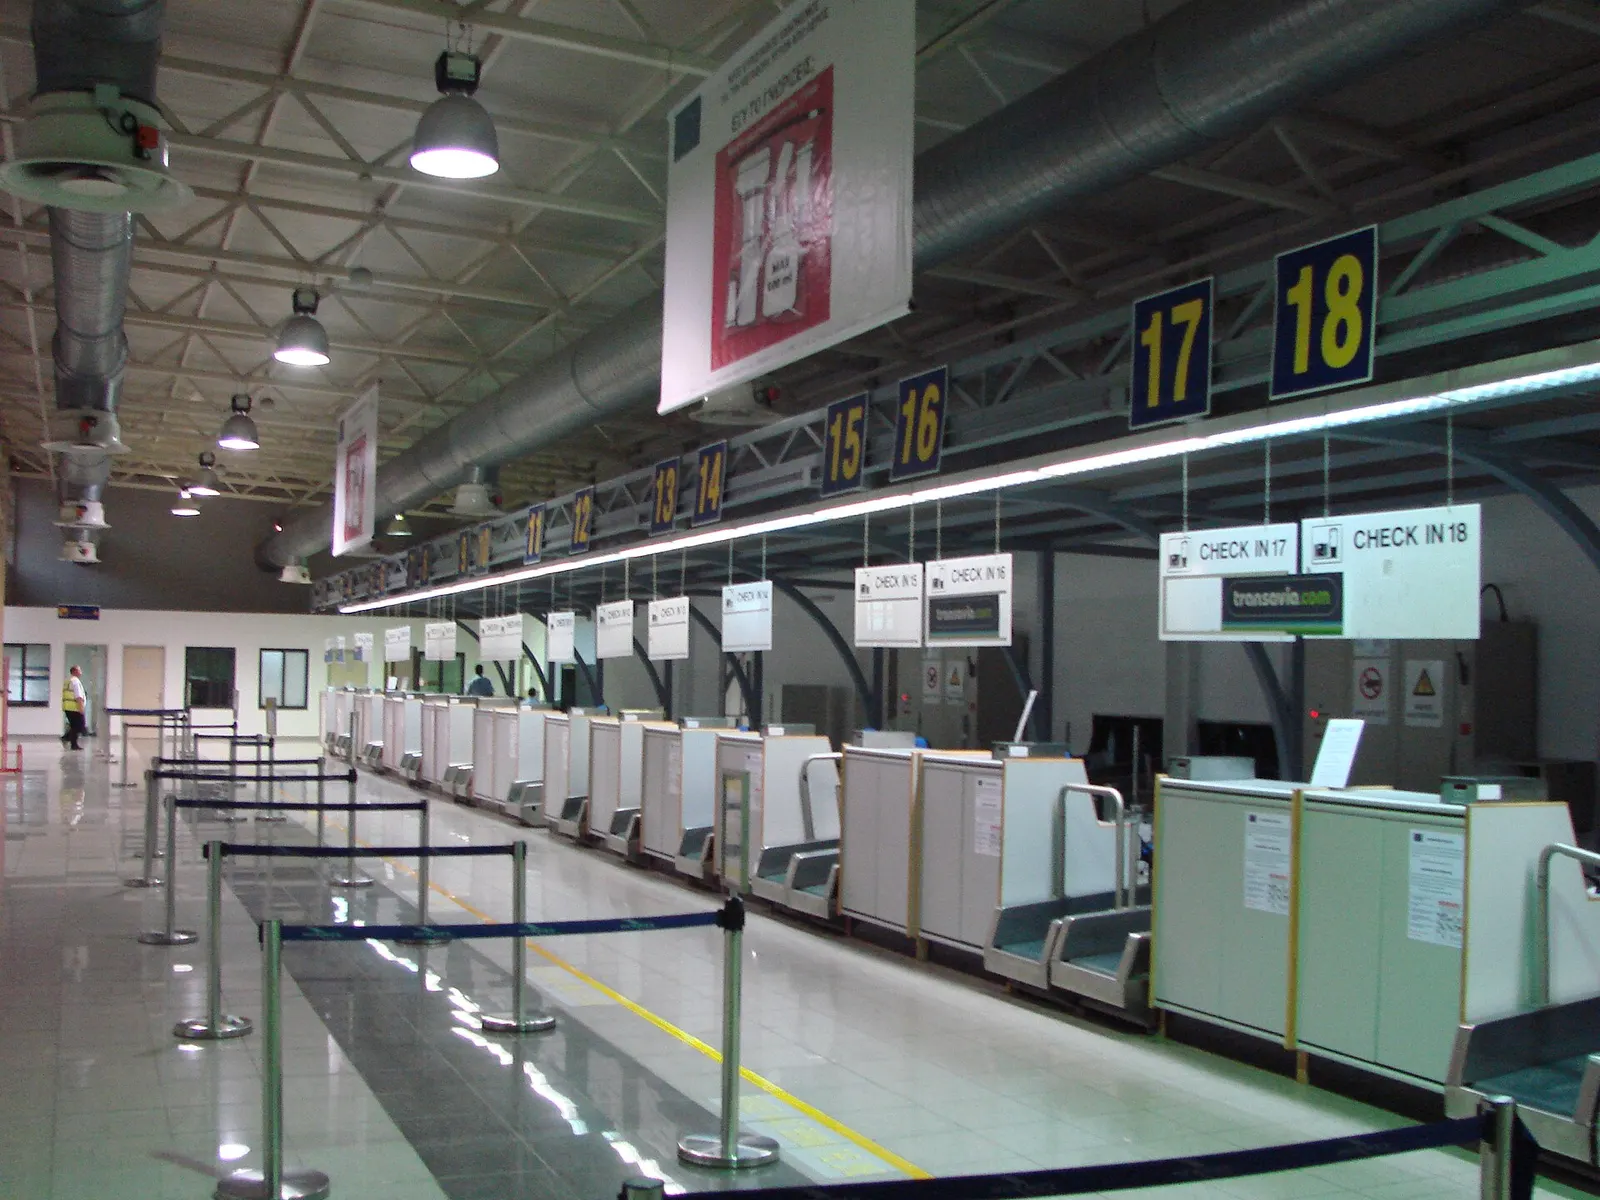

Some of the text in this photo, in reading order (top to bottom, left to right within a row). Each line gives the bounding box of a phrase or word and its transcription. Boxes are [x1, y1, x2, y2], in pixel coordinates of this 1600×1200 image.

[1287, 254, 1364, 374] 18
[1141, 298, 1204, 408] 17
[829, 406, 863, 482] 15
[902, 383, 940, 465] 16
[654, 466, 676, 524] 13
[698, 451, 723, 515] 14
[528, 510, 543, 556] 11
[573, 494, 592, 545] 12
[1353, 522, 1468, 550] CHECK IN 18
[951, 566, 1006, 584] CHECK IN 16
[1199, 539, 1287, 561] CHECK IN 17
[874, 575, 900, 589] CHECK
[902, 574, 910, 587] IN
